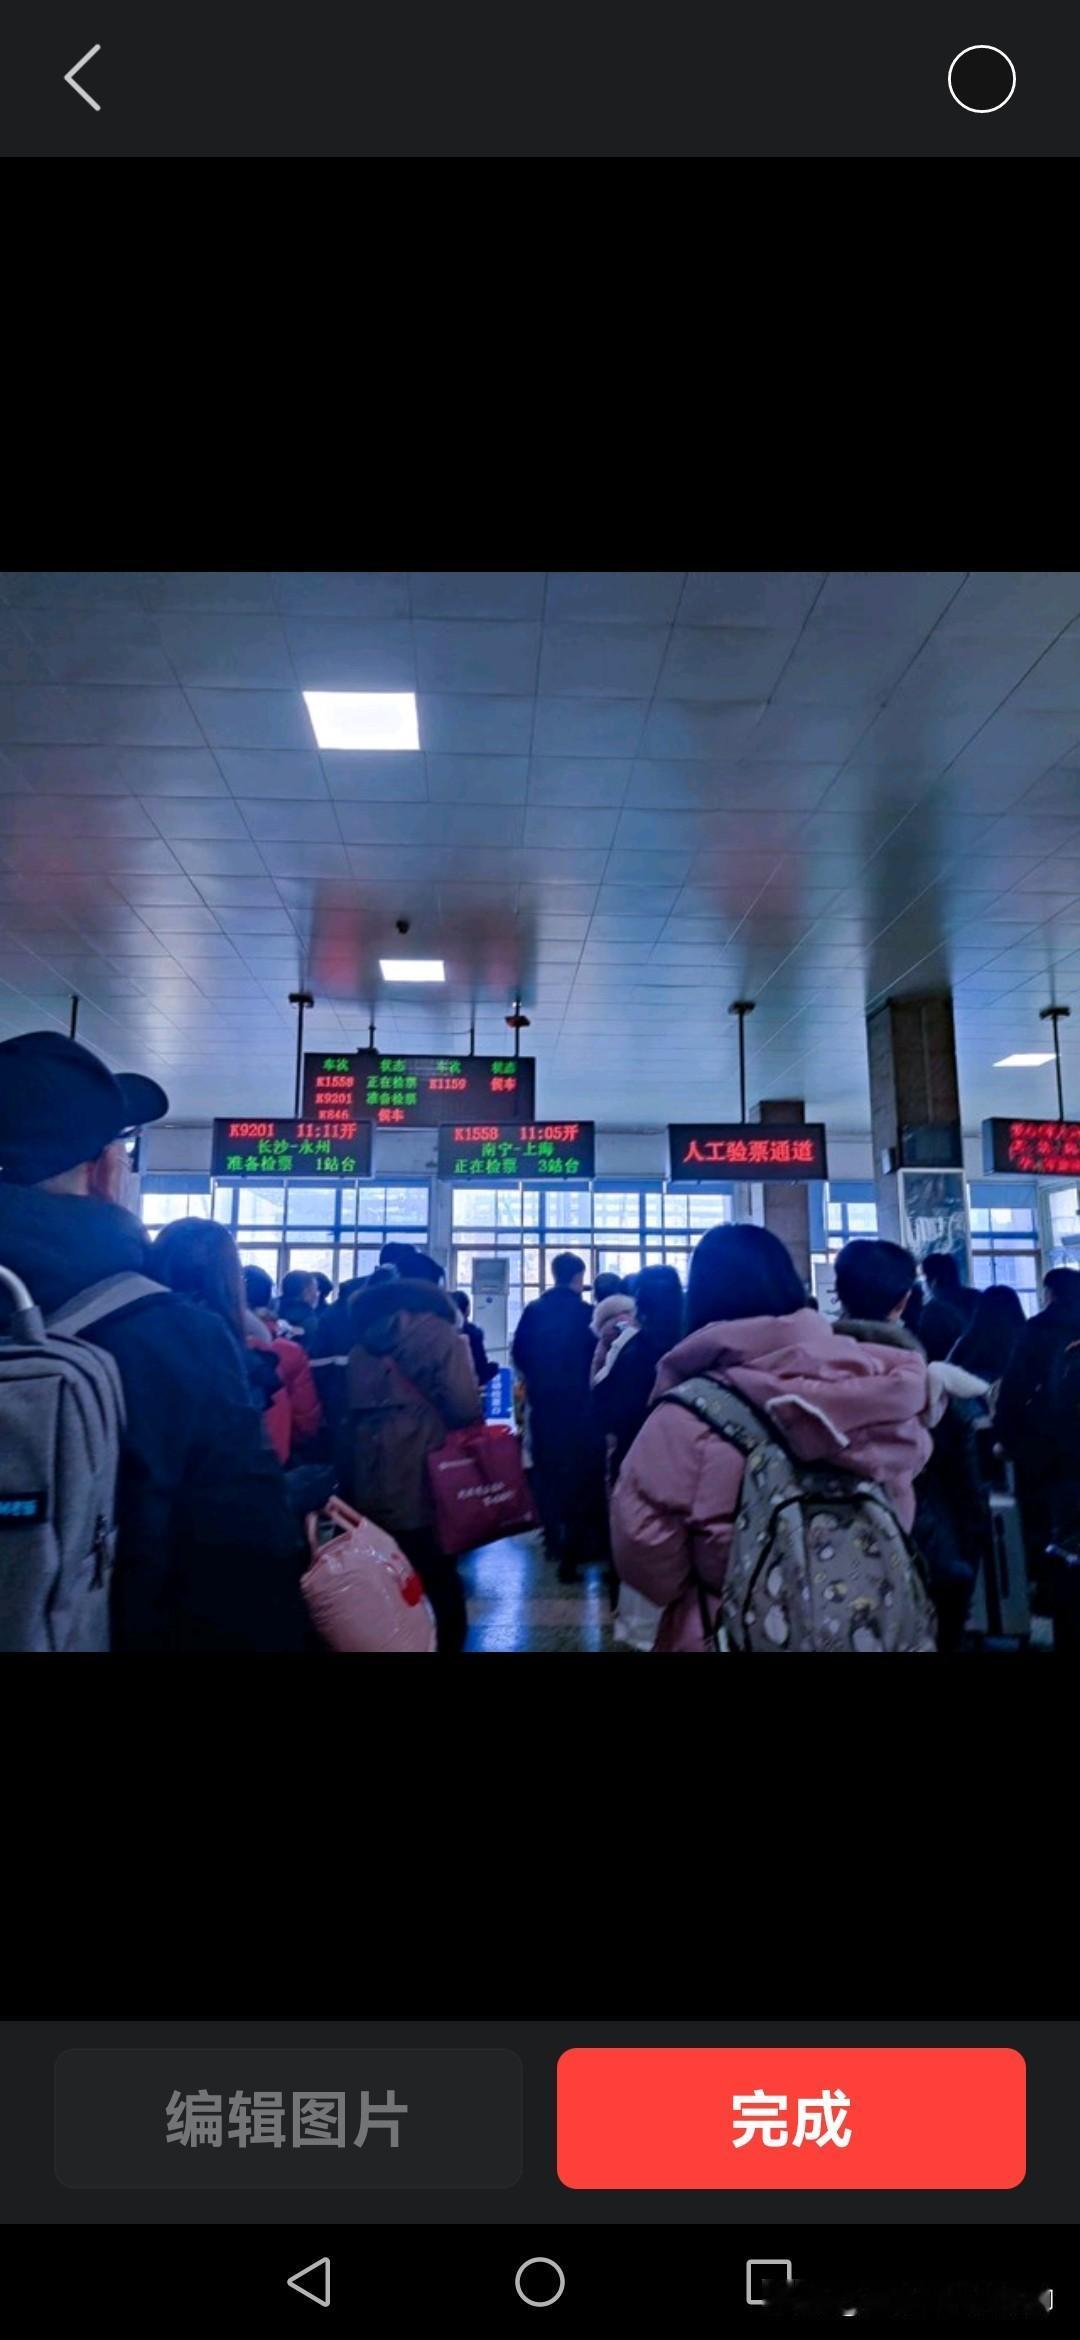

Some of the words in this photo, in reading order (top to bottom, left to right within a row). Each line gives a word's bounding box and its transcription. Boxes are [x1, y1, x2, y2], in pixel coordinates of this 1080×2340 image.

[367, 1076, 417, 1089] 正在检票
[429, 1078, 466, 1090] K1159
[491, 1078, 516, 1091] 候车
[316, 1092, 352, 1105] K9201
[366, 1092, 417, 1106] 准备检票
[318, 1109, 349, 1120] K846
[378, 1109, 404, 1122] 候车
[229, 1123, 275, 1137] K9201
[297, 1122, 356, 1139] 11:11开
[454, 1126, 498, 1141] K1558
[520, 1124, 579, 1141] 11:05开
[257, 1139, 331, 1155] 长沙-永州
[482, 1141, 555, 1157] 南宁-上海
[682, 1138, 815, 1163] 人工验票通道
[227, 1155, 293, 1171] 准备检票
[315, 1156, 356, 1172] 1站台
[453, 1158, 517, 1174] 正在检票
[538, 1157, 579, 1174] 3站台
